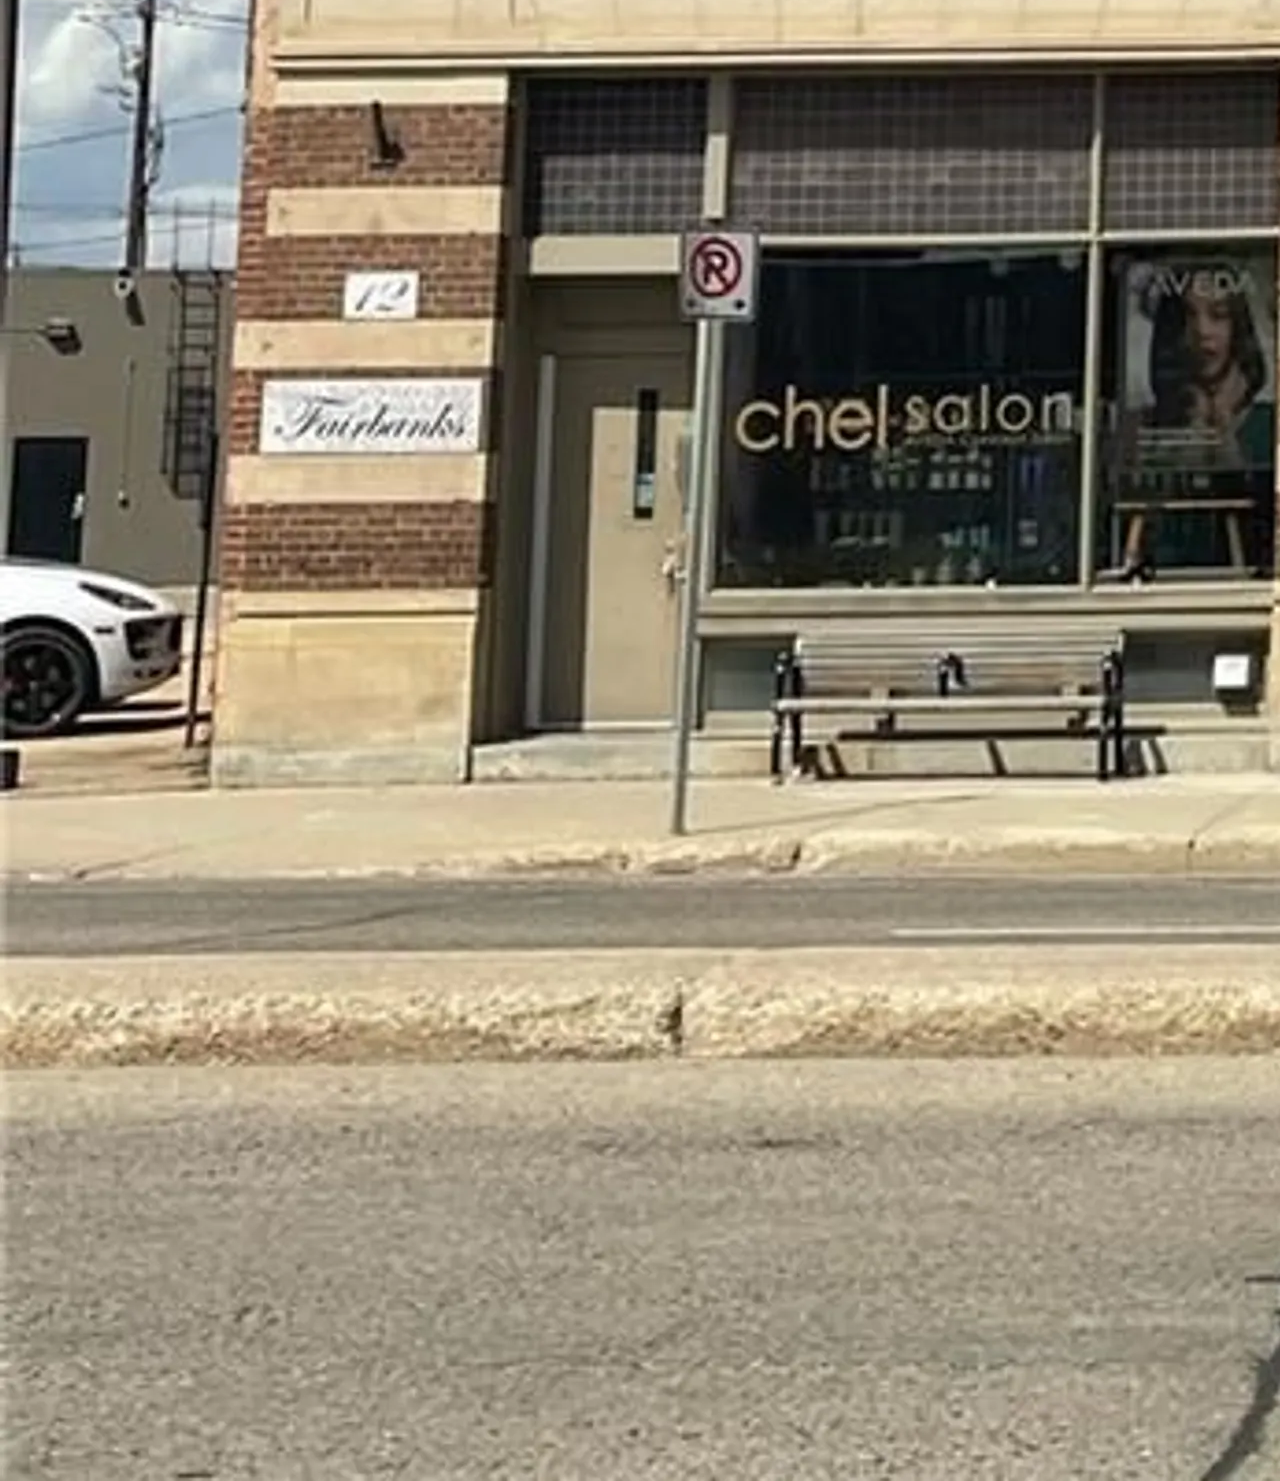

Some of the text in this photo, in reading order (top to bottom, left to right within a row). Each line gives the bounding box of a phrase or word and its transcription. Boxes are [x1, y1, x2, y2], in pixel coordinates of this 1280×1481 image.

[355, 278, 409, 312] 12
[273, 394, 466, 442] Fairbanks
[735, 383, 1073, 451] chel salon
